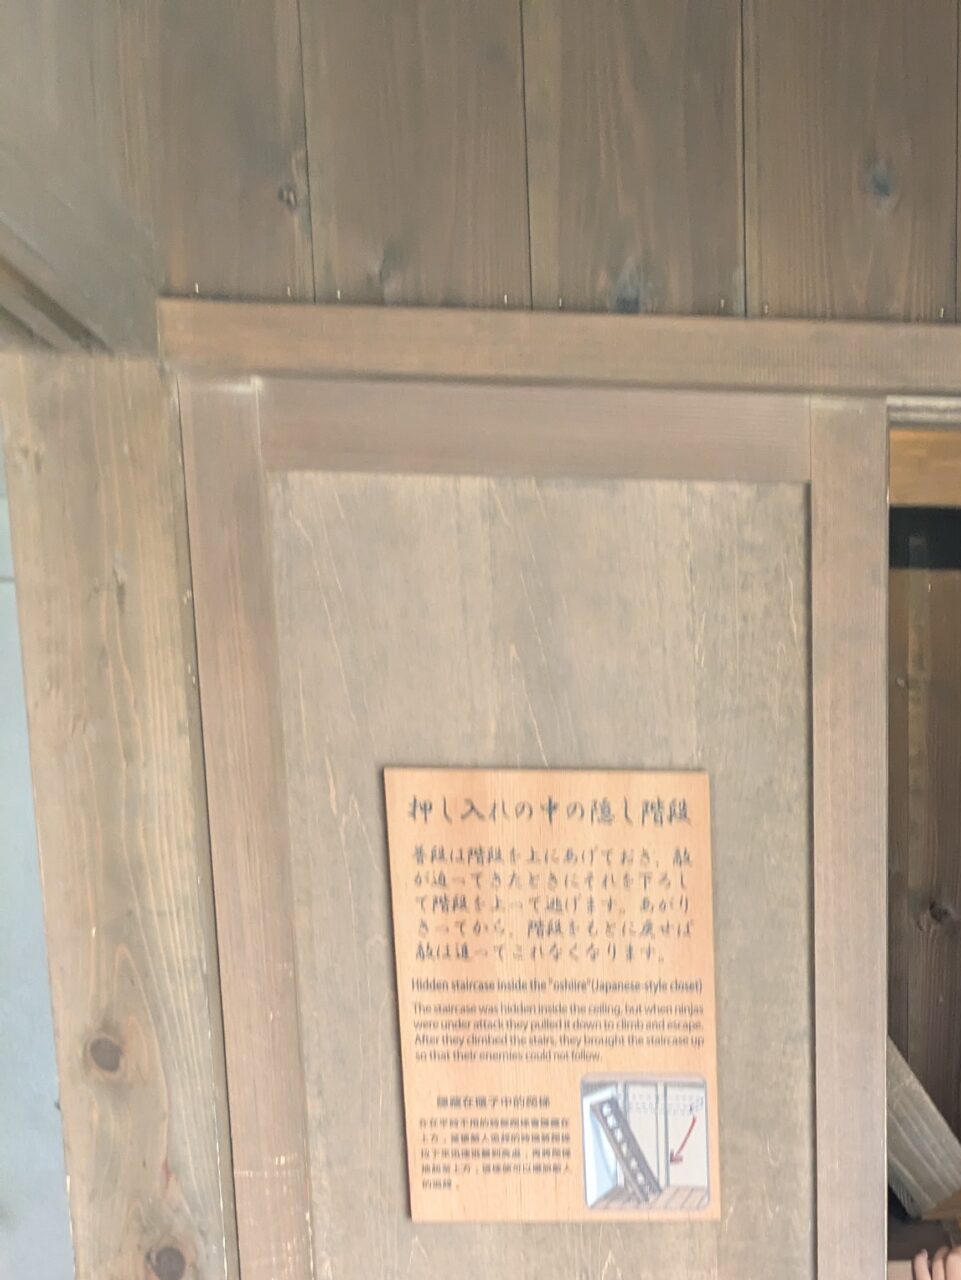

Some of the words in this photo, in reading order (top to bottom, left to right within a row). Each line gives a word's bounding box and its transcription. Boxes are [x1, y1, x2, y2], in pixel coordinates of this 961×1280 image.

[409, 794, 692, 827] 押し入れの中の隠し階段
[411, 977, 449, 992] Hidden
[451, 977, 495, 992] staircase
[497, 977, 528, 992] inside
[529, 978, 547, 992] the
[669, 977, 703, 994] closet)
[414, 1002, 432, 1014] The
[433, 1002, 477, 1015] staircase
[478, 1005, 499, 1015] was
[500, 1002, 536, 1015] hidden
[537, 1002, 568, 1015] inside
[570, 1003, 587, 1015] the
[624, 1003, 642, 1015] but
[644, 1003, 673, 1015] when
[674, 1003, 704, 1018] ninjas
[414, 1020, 439, 1030] were
[440, 1018, 471, 1030] under
[472, 1018, 504, 1030] attack
[506, 1018, 529, 1032] they
[530, 1018, 562, 1032] pulled
[572, 1018, 602, 1030] down
[603, 1020, 615, 1030] to
[616, 1018, 644, 1031] climb
[645, 1019, 665, 1031] and
[414, 1034, 439, 1045] After
[442, 1034, 465, 1048] they
[466, 1034, 508, 1046] climbed
[511, 1034, 527, 1046] the
[559, 1034, 582, 1048] they
[583, 1034, 625, 1048] brought
[627, 1034, 644, 1046] the
[646, 1034, 689, 1047] staircase
[690, 1037, 705, 1050] up
[415, 1051, 427, 1061] so
[429, 1050, 450, 1061] that
[453, 1050, 476, 1061] their
[479, 1051, 523, 1062] enemies
[525, 1050, 552, 1062] could
[553, 1051, 571, 1062] not
